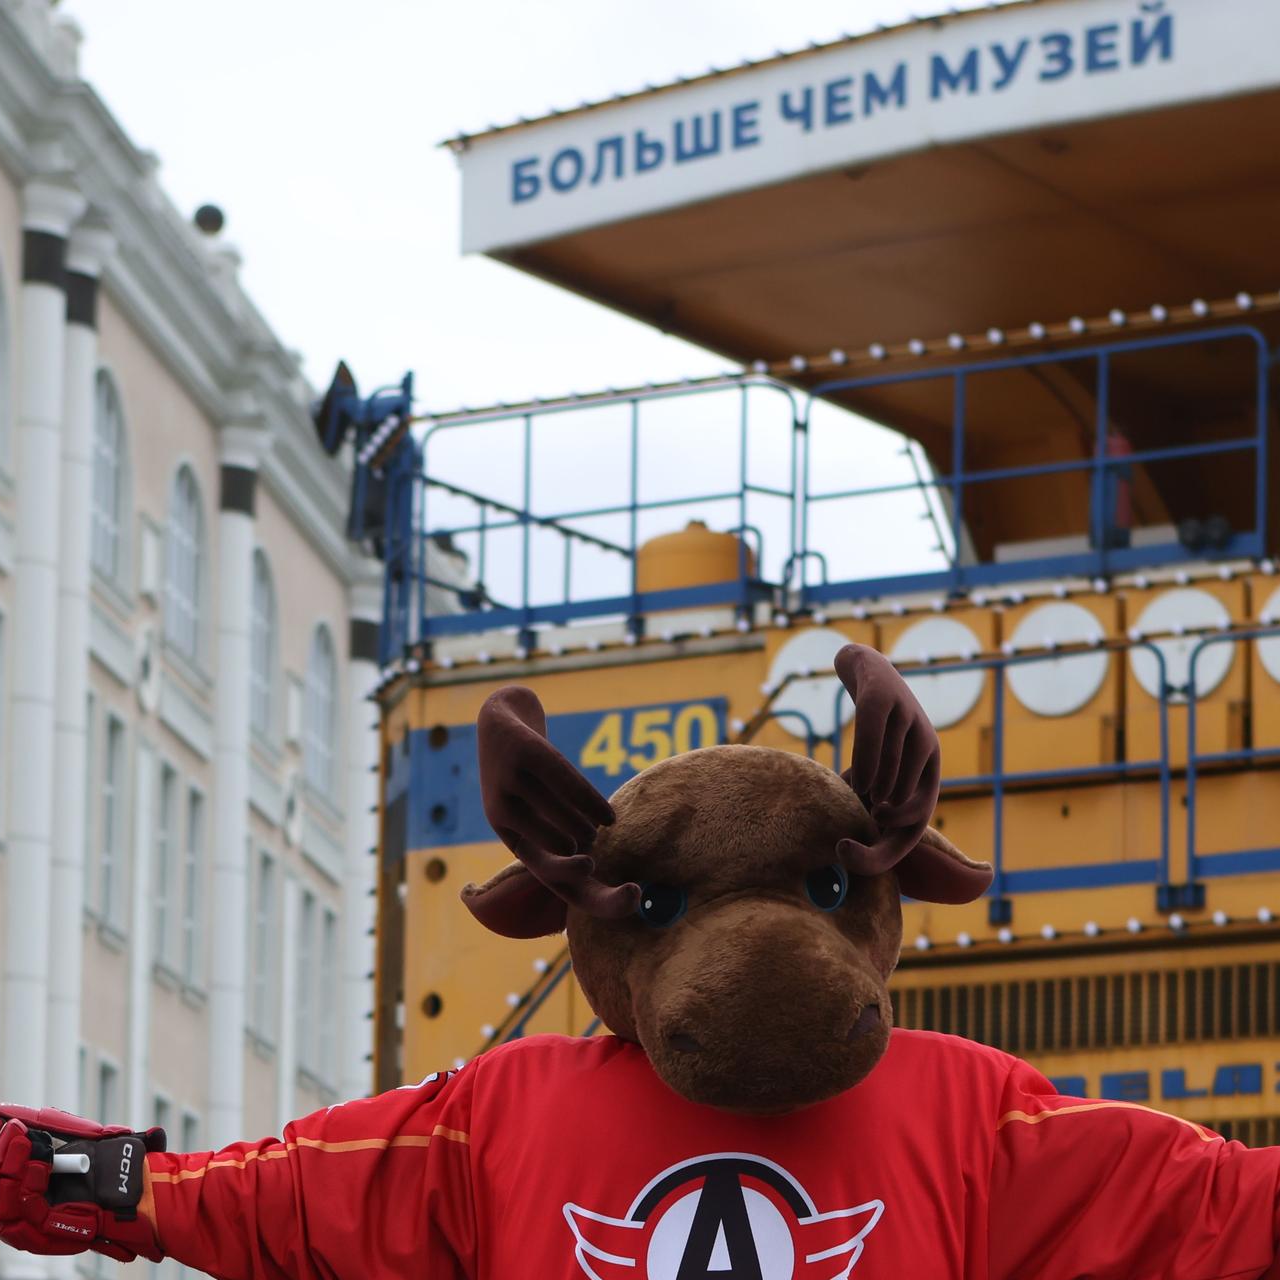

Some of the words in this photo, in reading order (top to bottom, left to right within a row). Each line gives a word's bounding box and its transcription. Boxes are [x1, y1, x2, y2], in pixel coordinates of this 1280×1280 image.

[510, 102, 761, 205] БОЛЬШЕ
[779, 64, 908, 134] ЧЕМ
[928, 2, 1176, 101] МУЗЕЙ
[580, 704, 718, 776] 450
[118, 1143, 133, 1194] CCM
